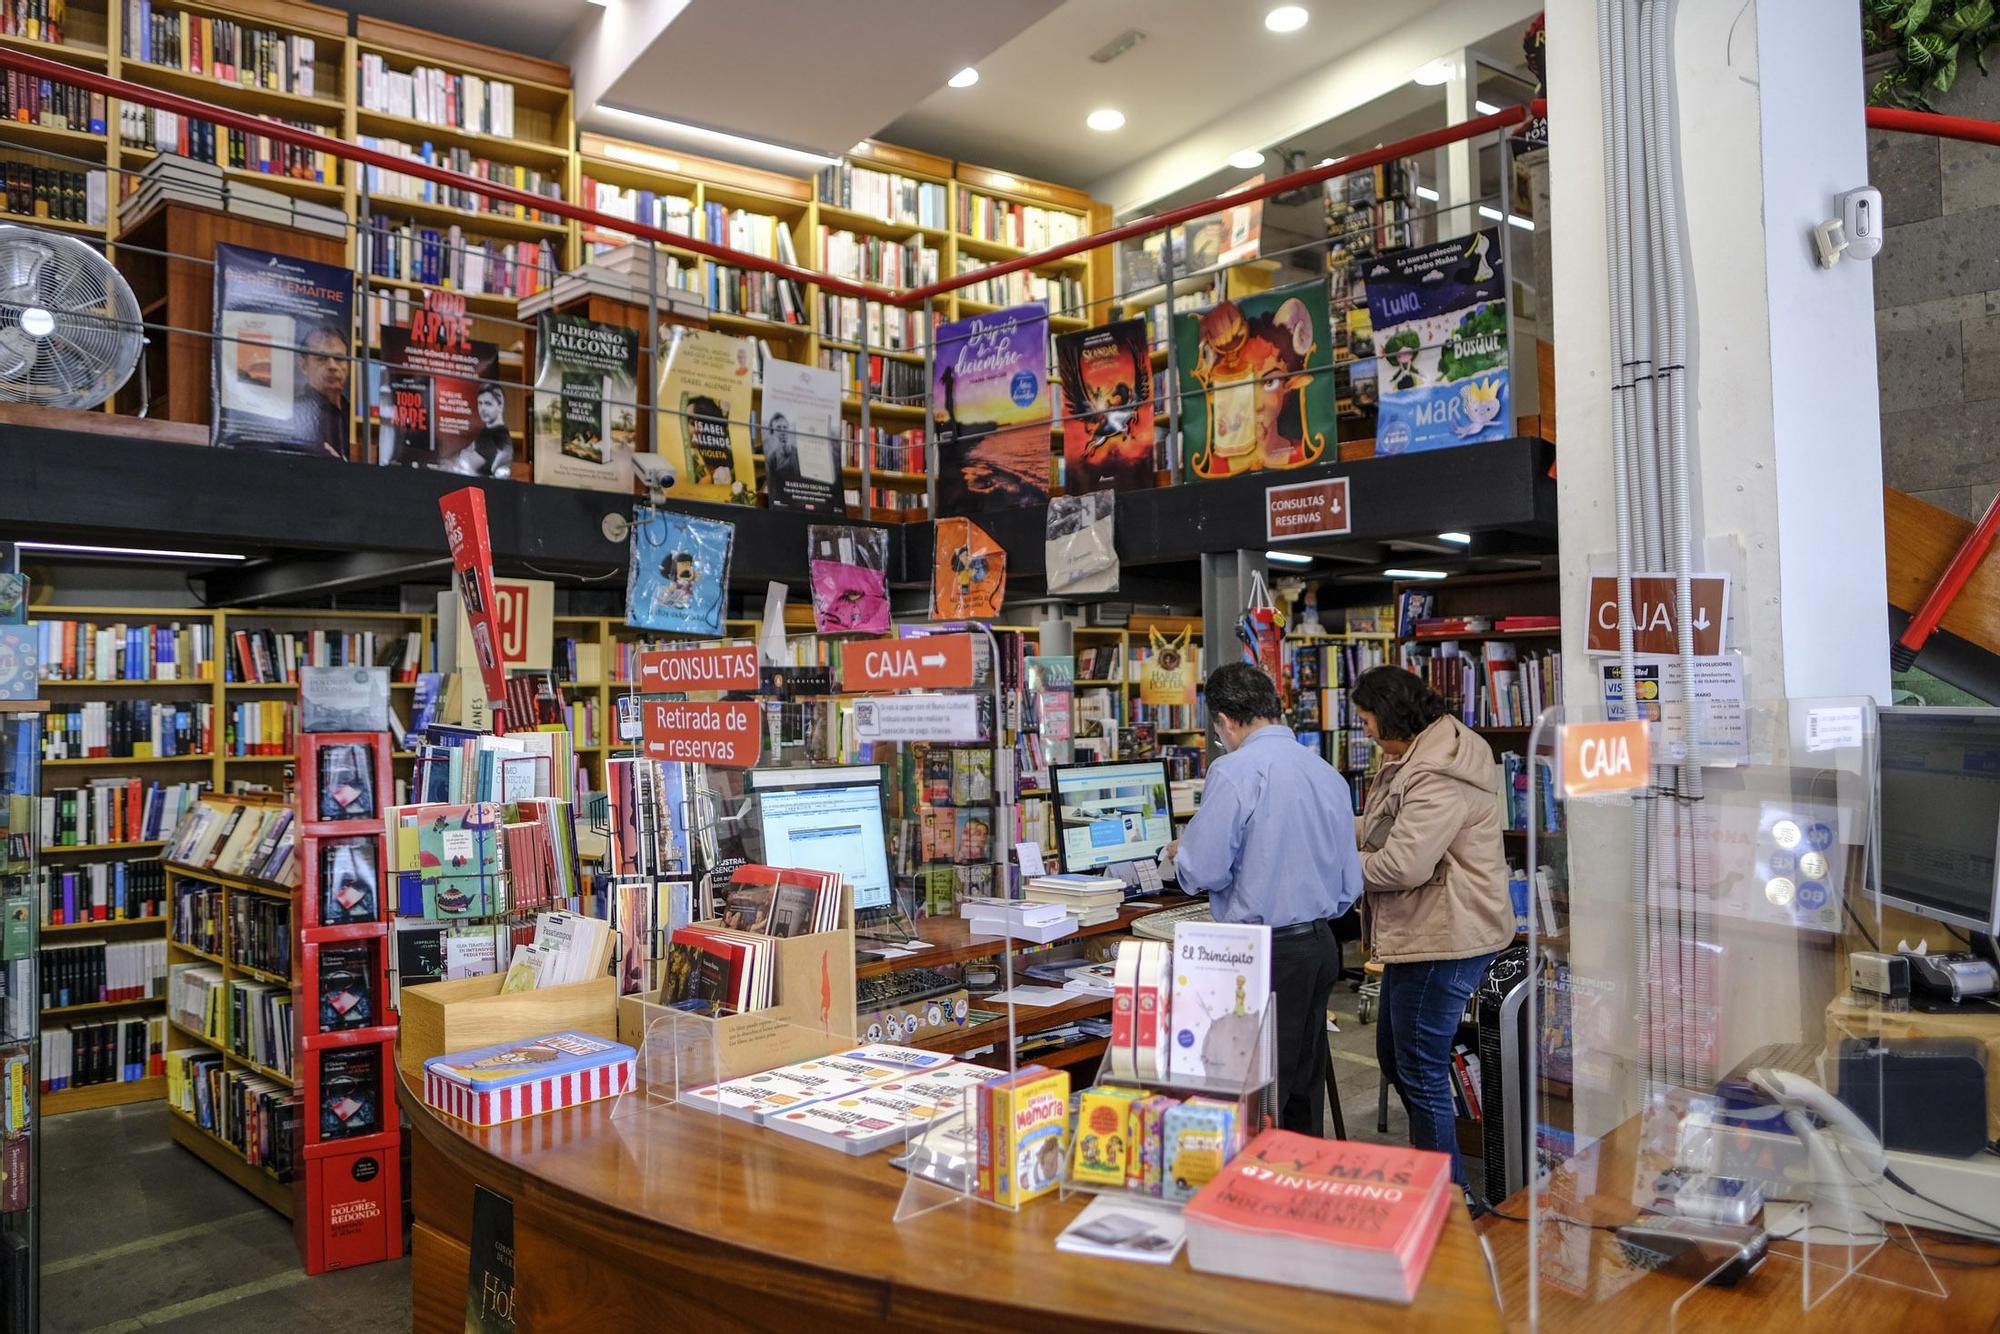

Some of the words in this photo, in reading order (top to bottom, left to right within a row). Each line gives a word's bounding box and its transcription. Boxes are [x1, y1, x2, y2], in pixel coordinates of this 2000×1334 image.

[279, 279, 345, 303] LEMAITRE
[422, 288, 466, 318] TODO
[411, 309, 473, 352] ARDE
[557, 323, 623, 345] ILDEFONSO
[550, 332, 630, 359] FALCONES
[396, 391, 422, 407] TODO
[391, 405, 428, 432] ARDE
[694, 420, 725, 436] ISABEL
[691, 432, 732, 449] ALLENDE
[1271, 495, 1325, 512] CONSULTAS
[1275, 511, 1321, 526] RESERVAS
[659, 653, 756, 682] CONSULTAS
[865, 649, 919, 679] CAJA
[1150, 679, 1185, 690] POTTER
[1151, 671, 1183, 682] HARRY
[1608, 683, 1623, 693] VIS
[656, 706, 721, 730] Retirada
[726, 705, 747, 732] de
[1611, 705, 1624, 715] VIS
[669, 739, 735, 759] reservas
[1580, 735, 1632, 779] CAJA
[1182, 945, 1194, 960] El
[1198, 947, 1254, 967] Principito
[1016, 1100, 1063, 1130] Memoria
[1241, 1165, 1275, 1181] 67
[1275, 1174, 1404, 1202] INVIERNO
[331, 1200, 377, 1217] DOLORES
[331, 1208, 381, 1225] REDONDO
